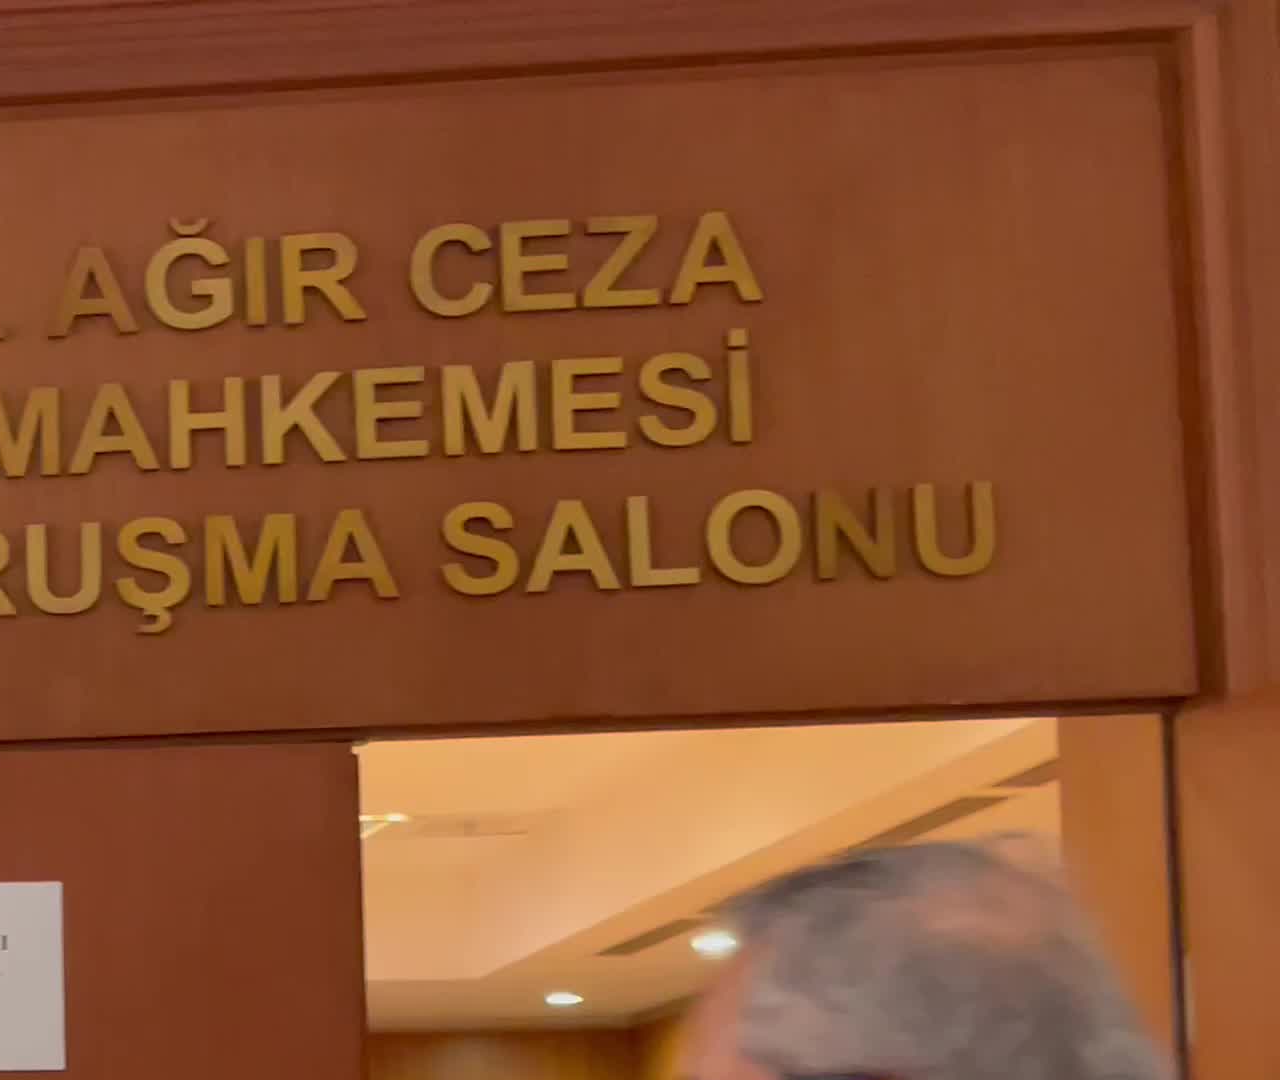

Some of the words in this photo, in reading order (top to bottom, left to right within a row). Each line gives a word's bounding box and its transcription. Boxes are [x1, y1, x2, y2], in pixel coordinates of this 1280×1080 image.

[48, 216, 367, 341] AĞIR
[409, 211, 763, 317] CEZA
[441, 481, 995, 596] SALONU
